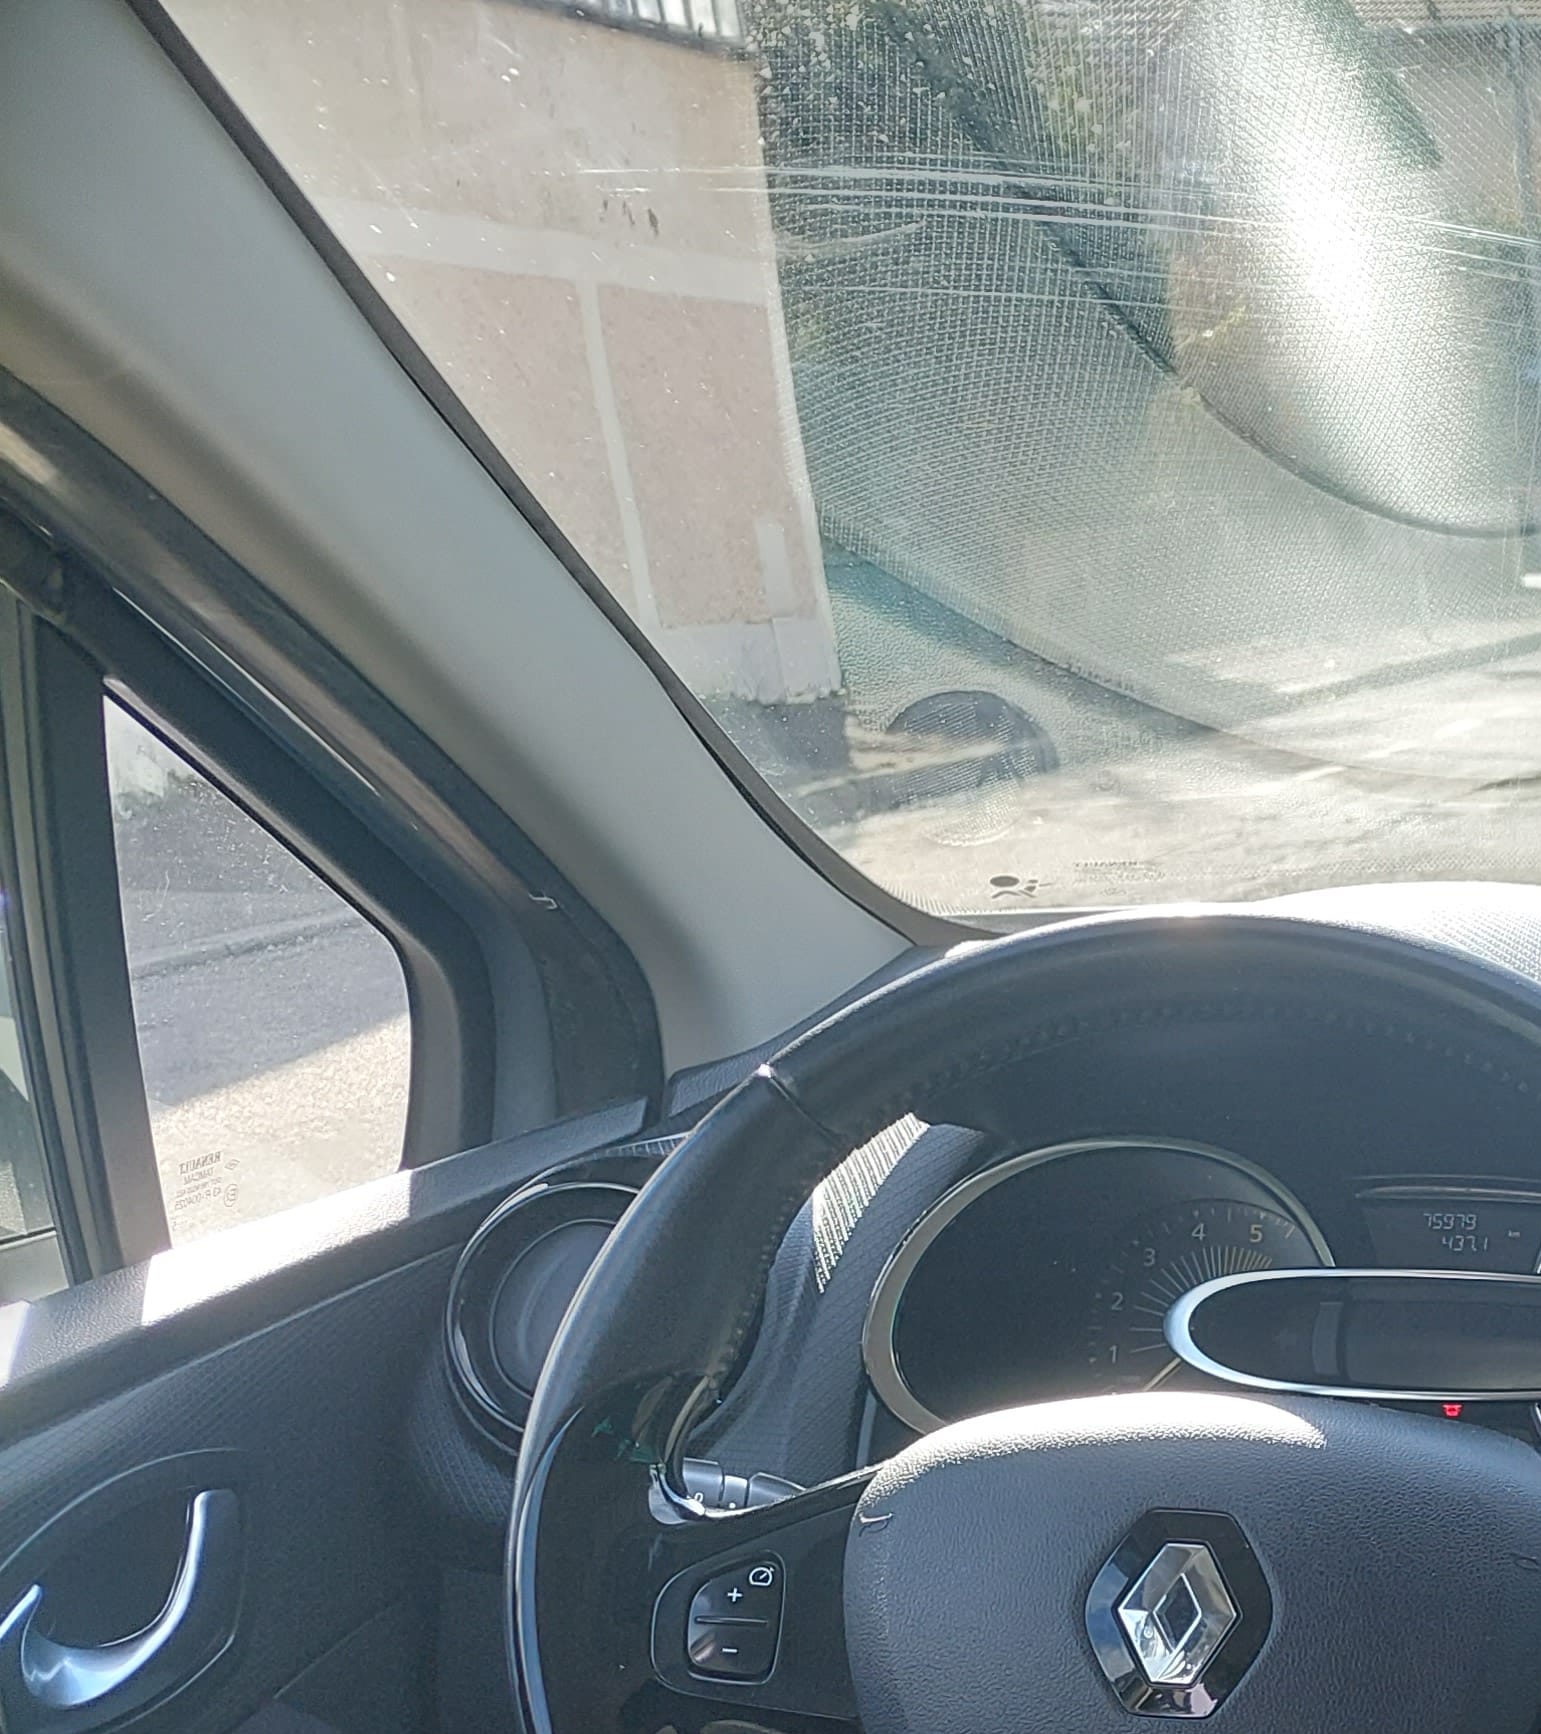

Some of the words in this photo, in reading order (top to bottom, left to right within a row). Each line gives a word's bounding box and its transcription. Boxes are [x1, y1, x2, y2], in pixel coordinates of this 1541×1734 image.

[1423, 1212, 1478, 1231] 75979
[1191, 1222, 1207, 1241] 4
[1249, 1224, 1264, 1243] 5
[1143, 1247, 1156, 1267] 3
[1110, 1291, 1124, 1311] 2
[1109, 1344, 1118, 1364] 1
